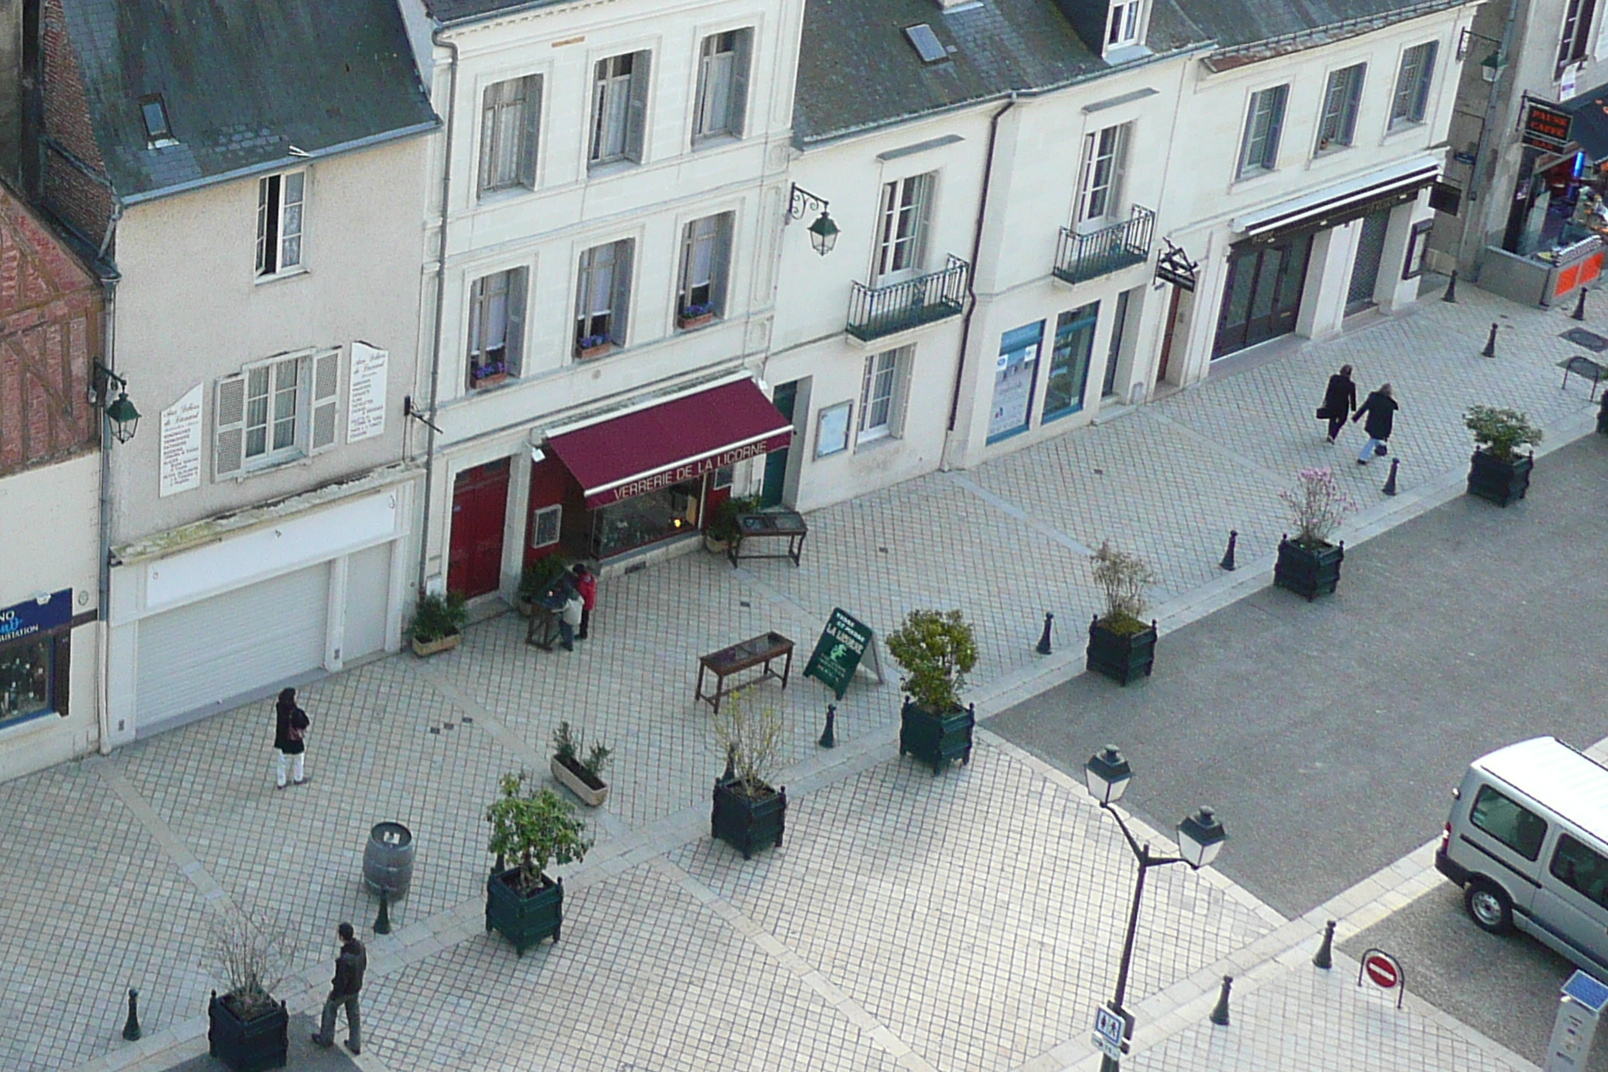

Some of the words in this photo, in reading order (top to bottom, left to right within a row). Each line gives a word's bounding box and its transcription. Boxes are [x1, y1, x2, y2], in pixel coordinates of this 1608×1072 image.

[613, 471, 673, 501] VERRERIE
[676, 466, 693, 481] DE
[697, 458, 713, 474] LA
[717, 441, 768, 468] LICORNE
[826, 623, 837, 637] LA
